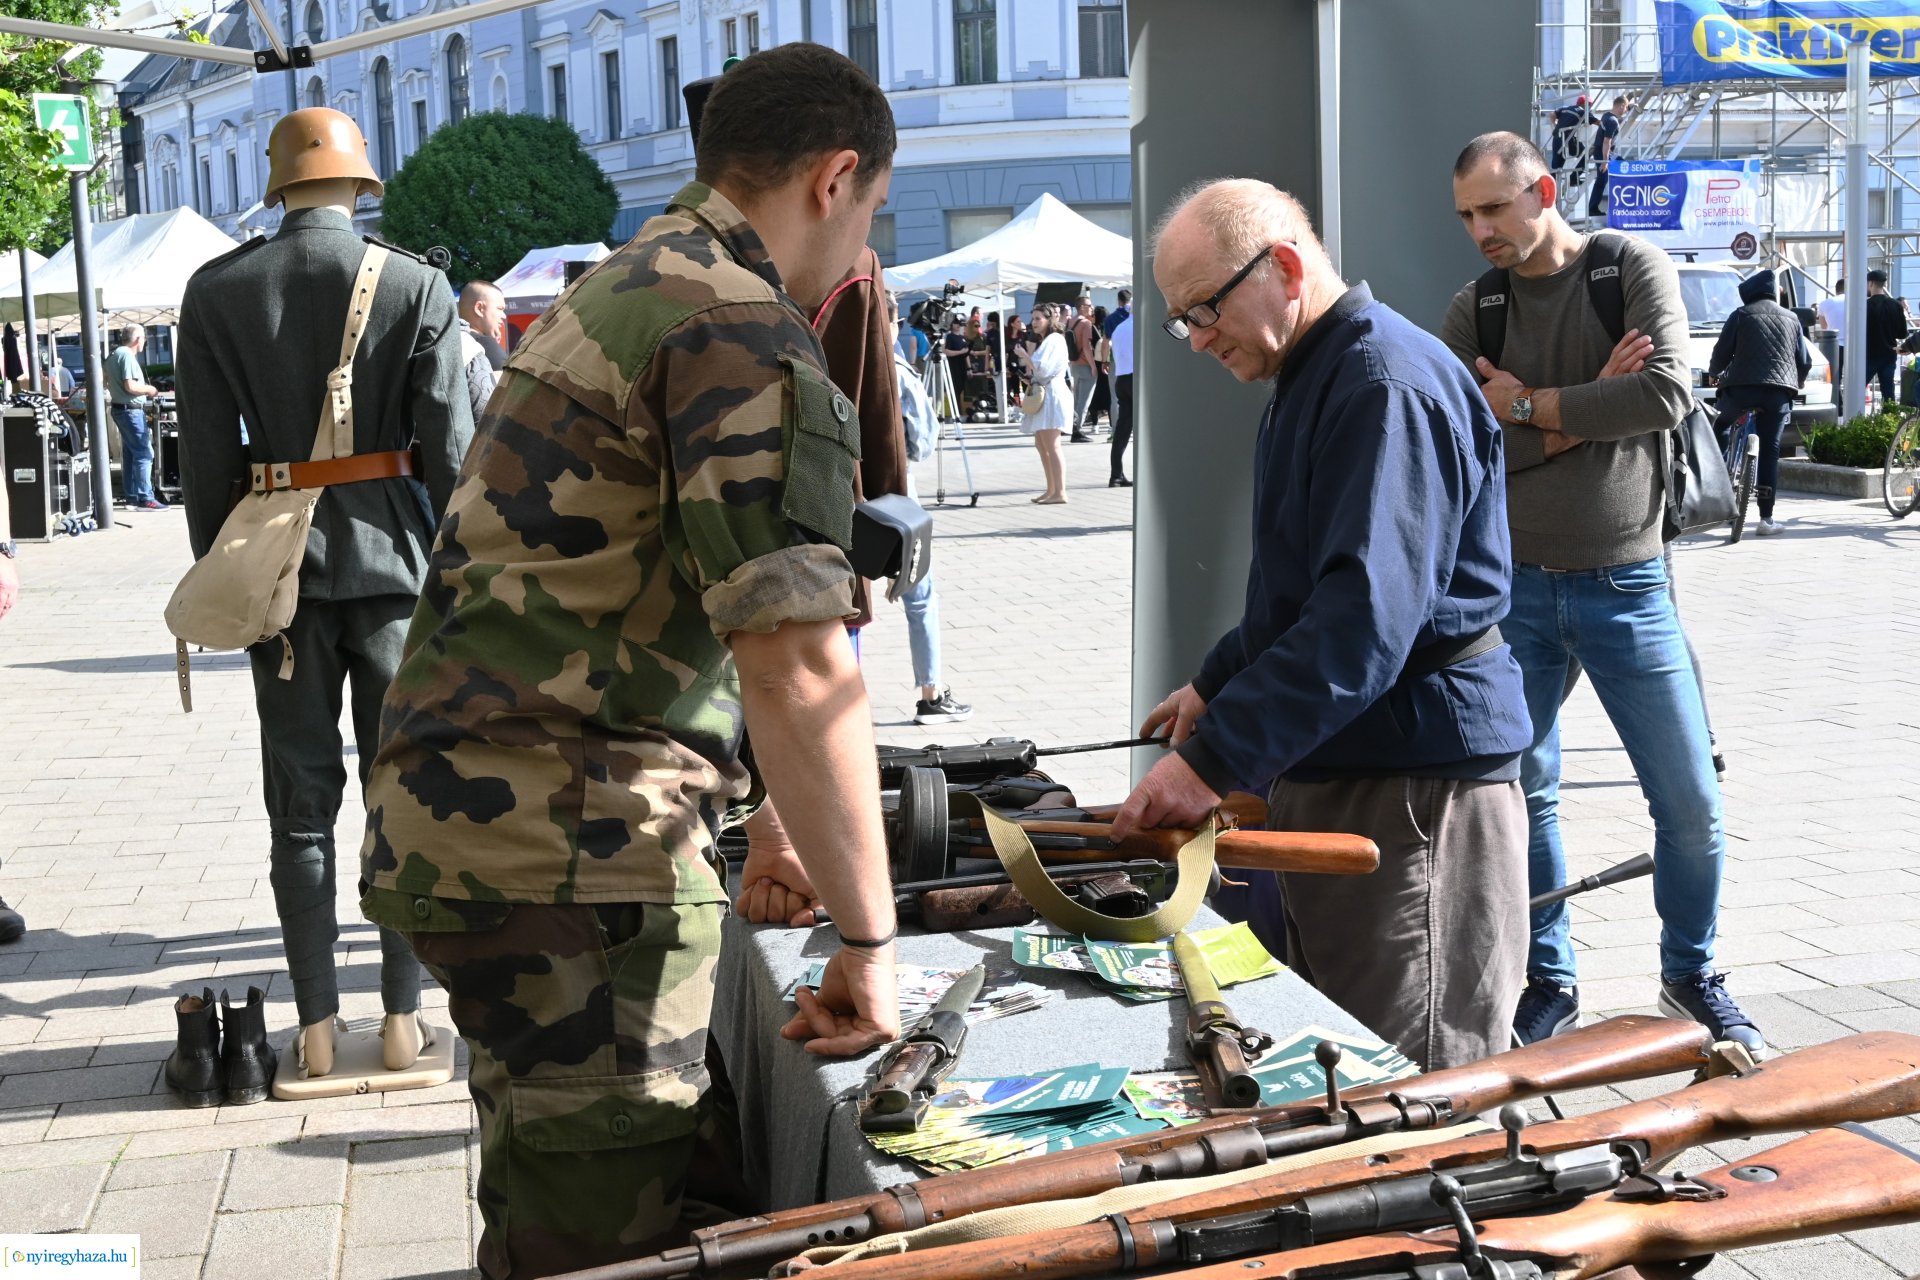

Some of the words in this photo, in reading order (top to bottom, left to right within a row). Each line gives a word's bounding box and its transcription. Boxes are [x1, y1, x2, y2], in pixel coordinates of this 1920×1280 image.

[1631, 164, 1654, 172] SENIO
[1655, 163, 1667, 172] KFT.
[1612, 185, 1671, 207] SENIO
[1694, 207, 1752, 218] CSEMPEBOLT
[1703, 220, 1744, 228] www.pietra.hu
[1593, 268, 1616, 279] FILA
[1480, 296, 1502, 306] FILA
